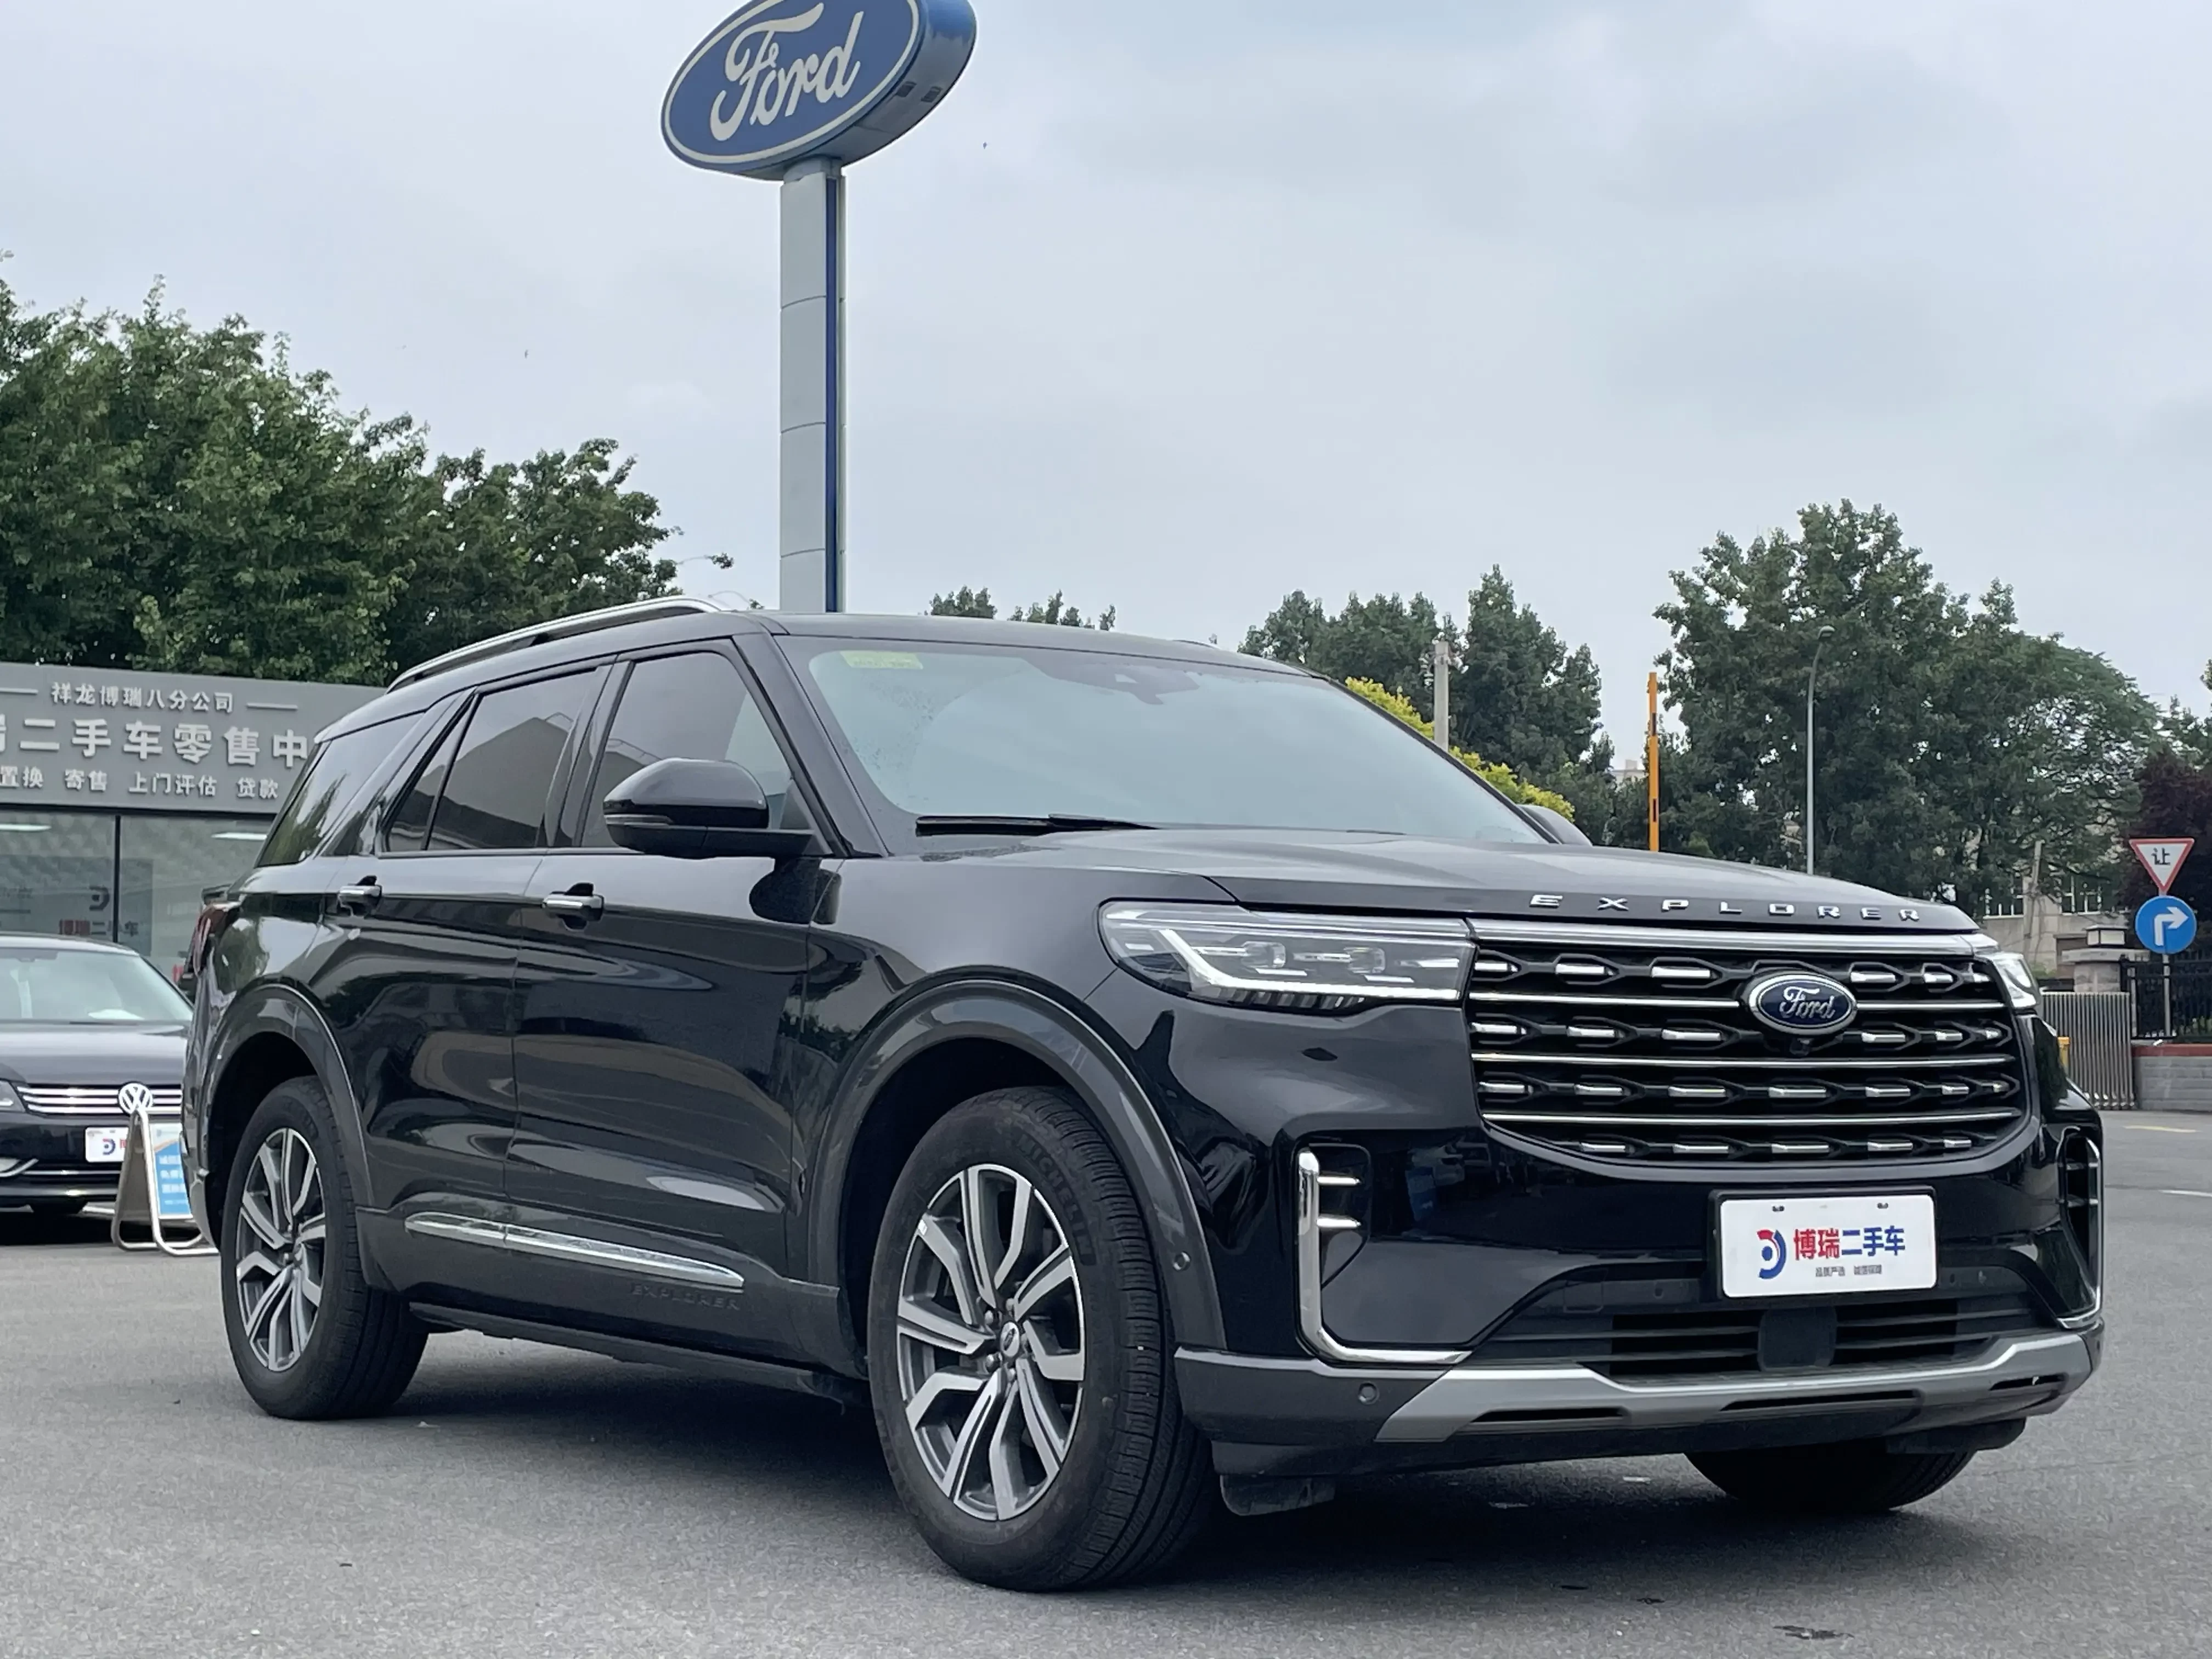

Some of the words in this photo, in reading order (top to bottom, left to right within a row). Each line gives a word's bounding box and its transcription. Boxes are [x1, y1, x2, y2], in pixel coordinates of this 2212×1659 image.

[710, 2, 864, 141] Ford
[51, 682, 234, 713] 祥龙博瑞八分公司
[0, 714, 308, 768] 二手车零售中
[64, 769, 108, 791] 寄售
[128, 771, 217, 797] 上门评估
[236, 777, 279, 799] 贷款
[2151, 847, 2171, 865] 让
[1528, 894, 1920, 922] EXPLORER
[1779, 986, 1836, 1019] Ford
[1015, 1132, 1092, 1256] MICHELIN
[1793, 1225, 1906, 1261] 博瑞二手车
[632, 1284, 740, 1311] EXPLORER
